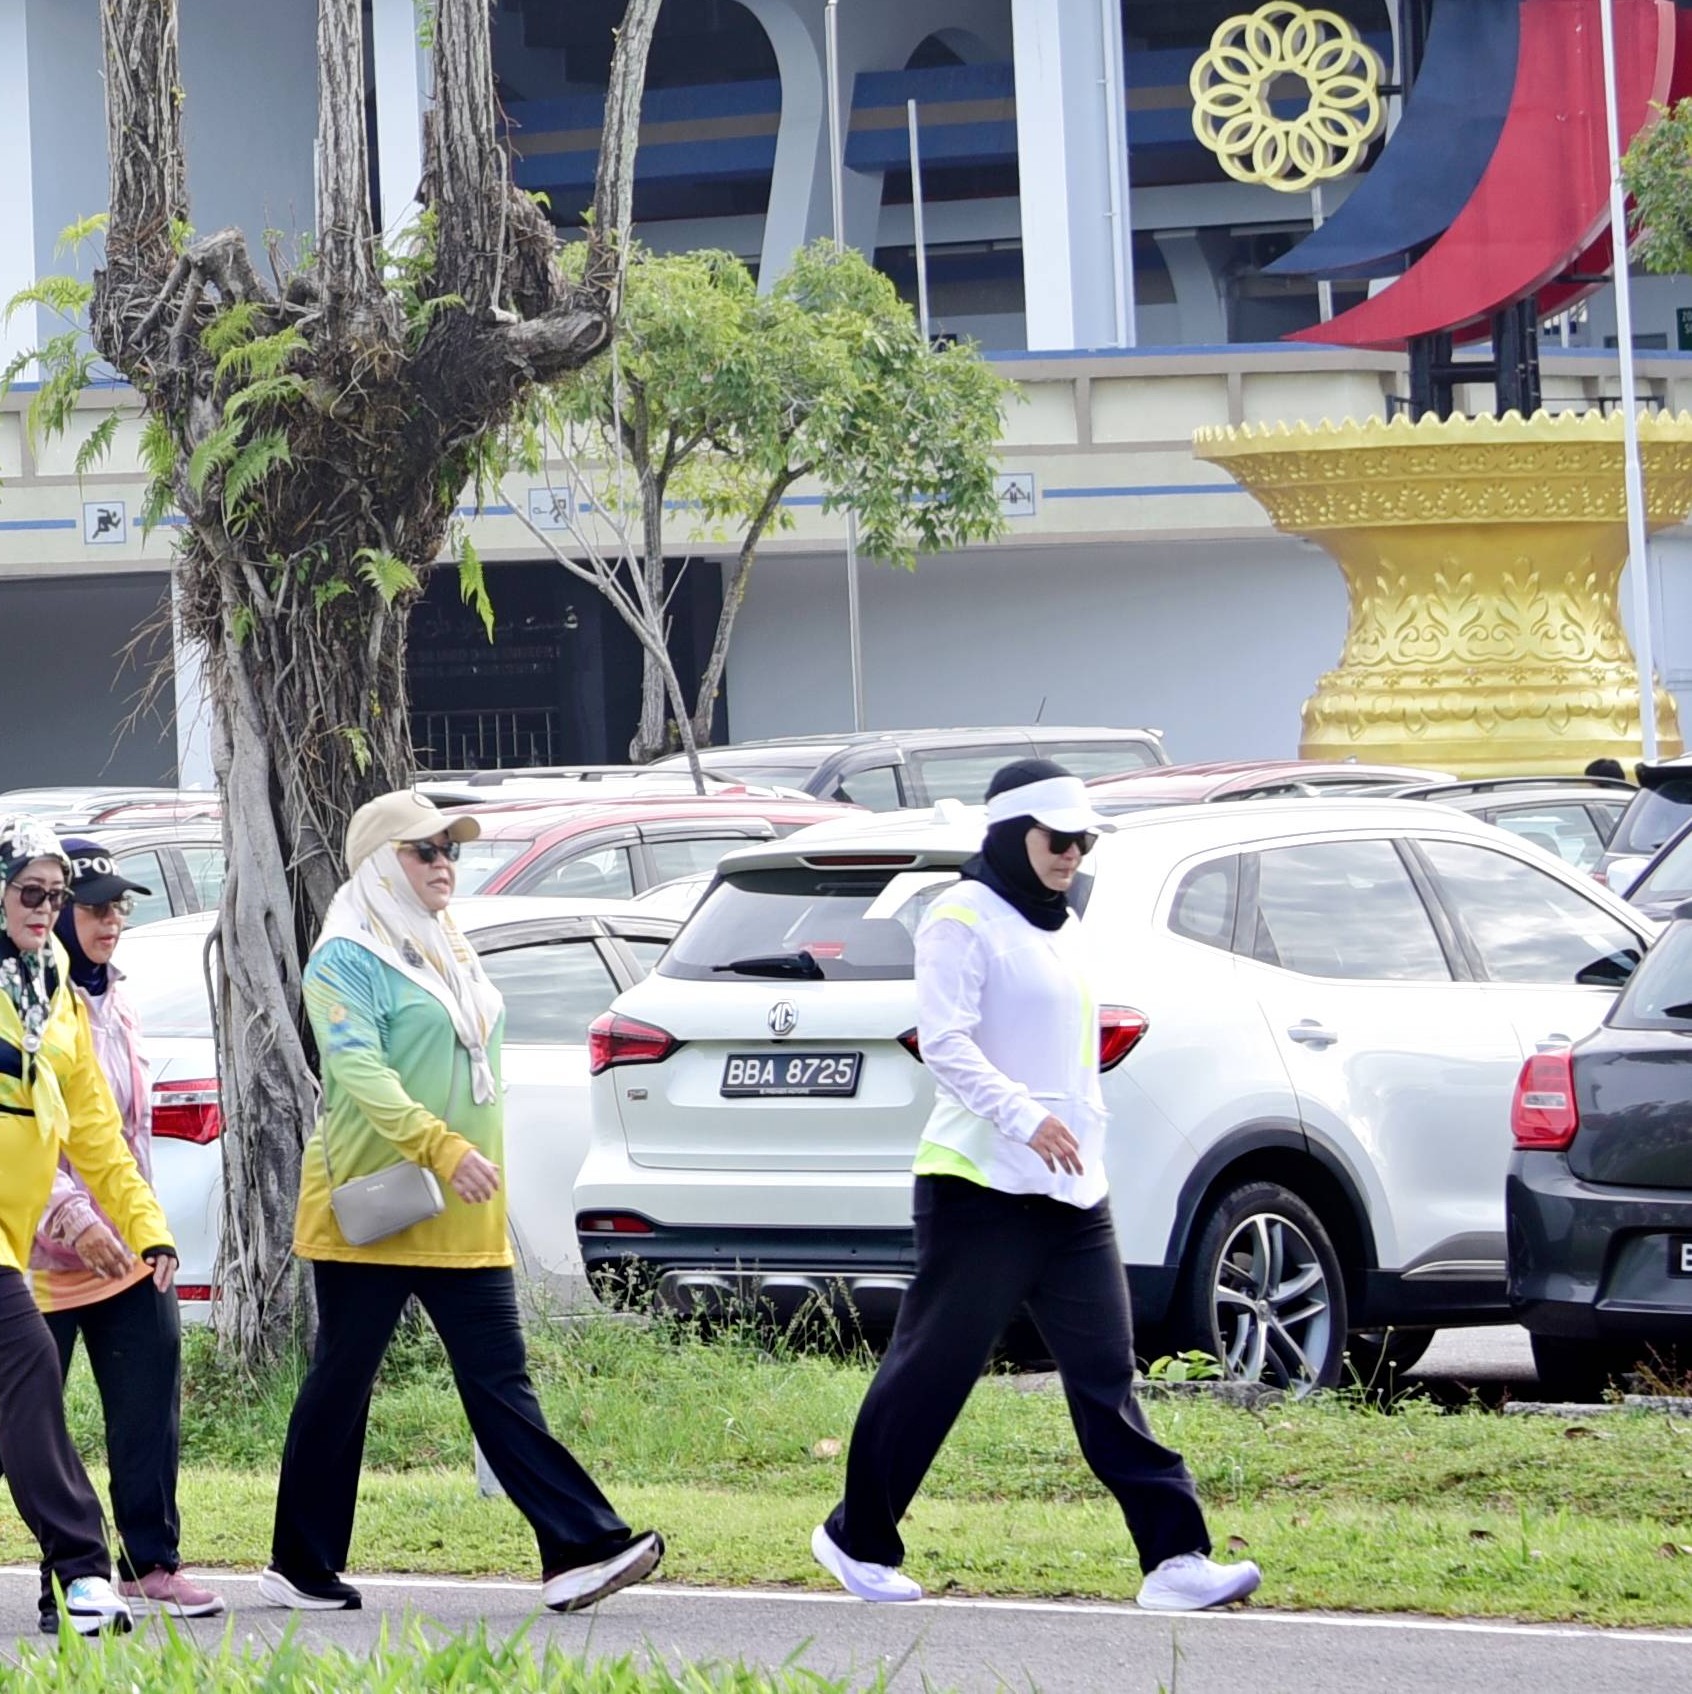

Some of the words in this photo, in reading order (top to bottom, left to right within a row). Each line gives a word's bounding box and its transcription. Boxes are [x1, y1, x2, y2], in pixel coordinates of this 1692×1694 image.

[768, 1002, 795, 1033] MG
[727, 1059, 775, 1085] BBA
[785, 1058, 854, 1084] 8725
